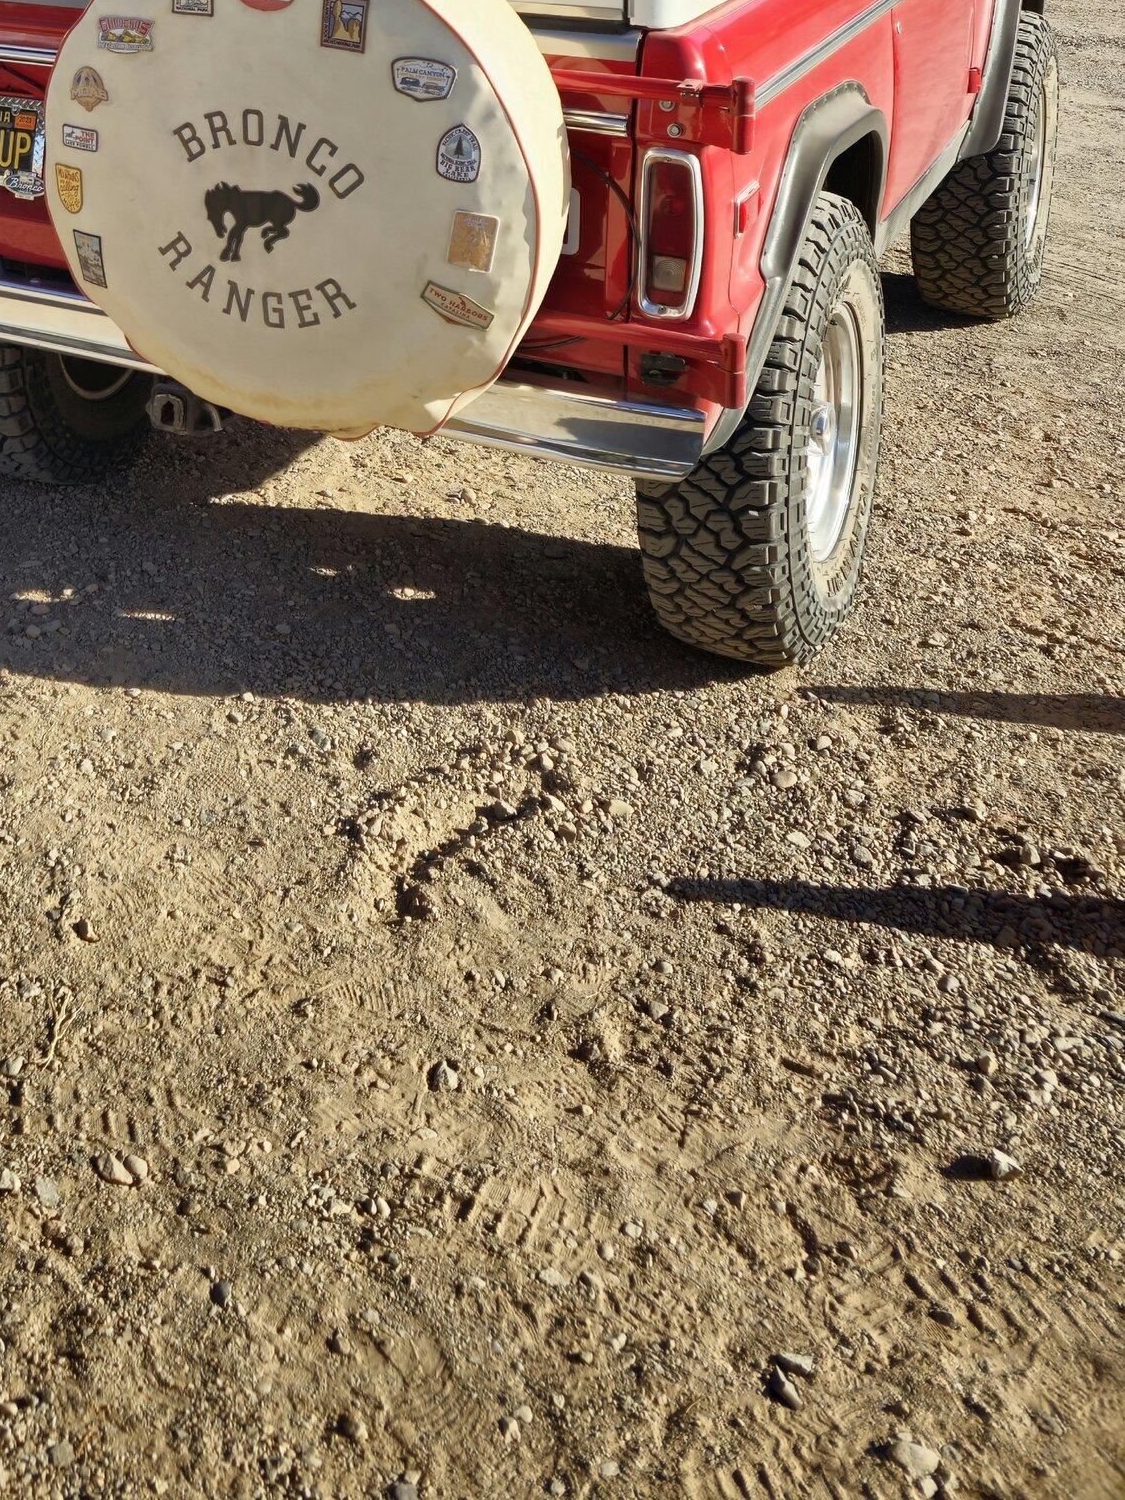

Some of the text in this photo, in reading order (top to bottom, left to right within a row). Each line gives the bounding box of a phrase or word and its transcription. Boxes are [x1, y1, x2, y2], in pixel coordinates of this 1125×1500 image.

[401, 66, 418, 75] PALM
[418, 68, 445, 79] CANYON
[75, 136, 94, 145] POINT
[81, 130, 95, 139] THE
[172, 108, 365, 200] BRONCO
[8, 177, 44, 192] Bronco
[157, 230, 358, 329] RANGER
[429, 287, 488, 322] TWO HARBORS
